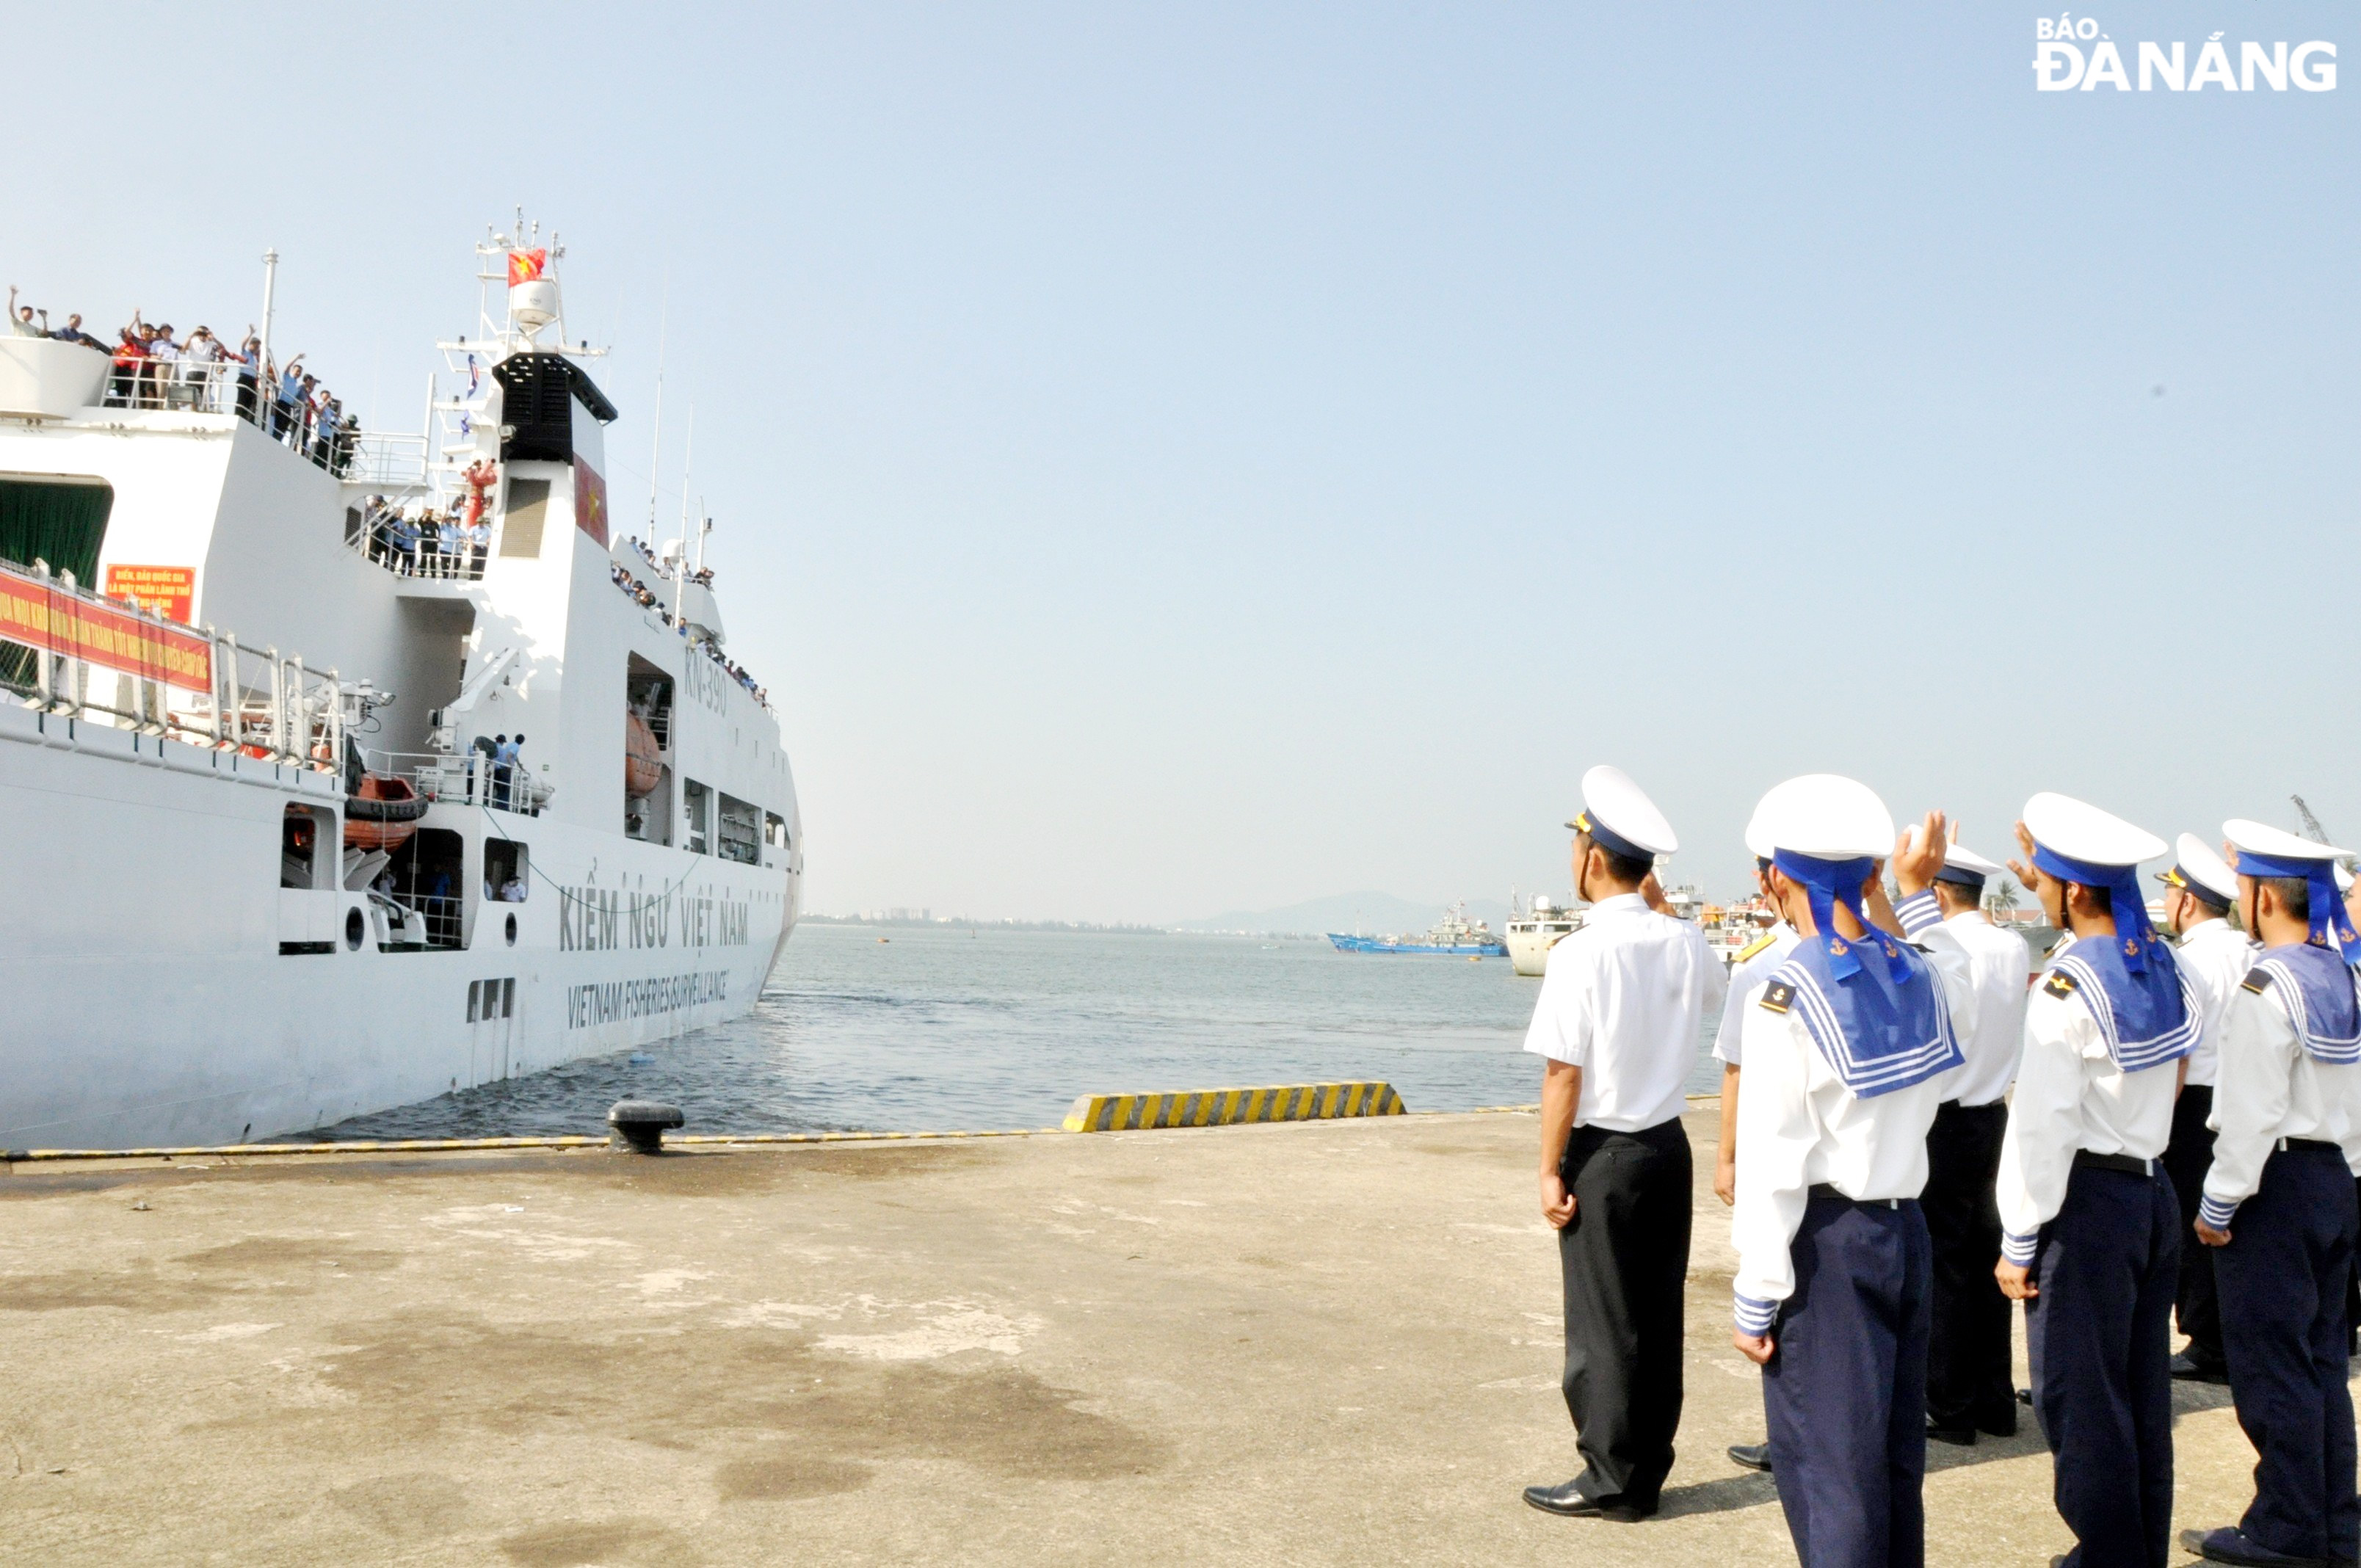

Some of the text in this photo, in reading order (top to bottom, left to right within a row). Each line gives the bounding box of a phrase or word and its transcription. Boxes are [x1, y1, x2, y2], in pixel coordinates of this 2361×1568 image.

[108, 582, 118, 594] LÀ
[173, 573, 186, 583] GIA
[684, 645, 727, 719] KN-390
[559, 856, 748, 959] KIỂM NGƯ VIỆT NAM
[568, 970, 727, 1030] VIETNAM FISHERIES SURVEILLANCE
